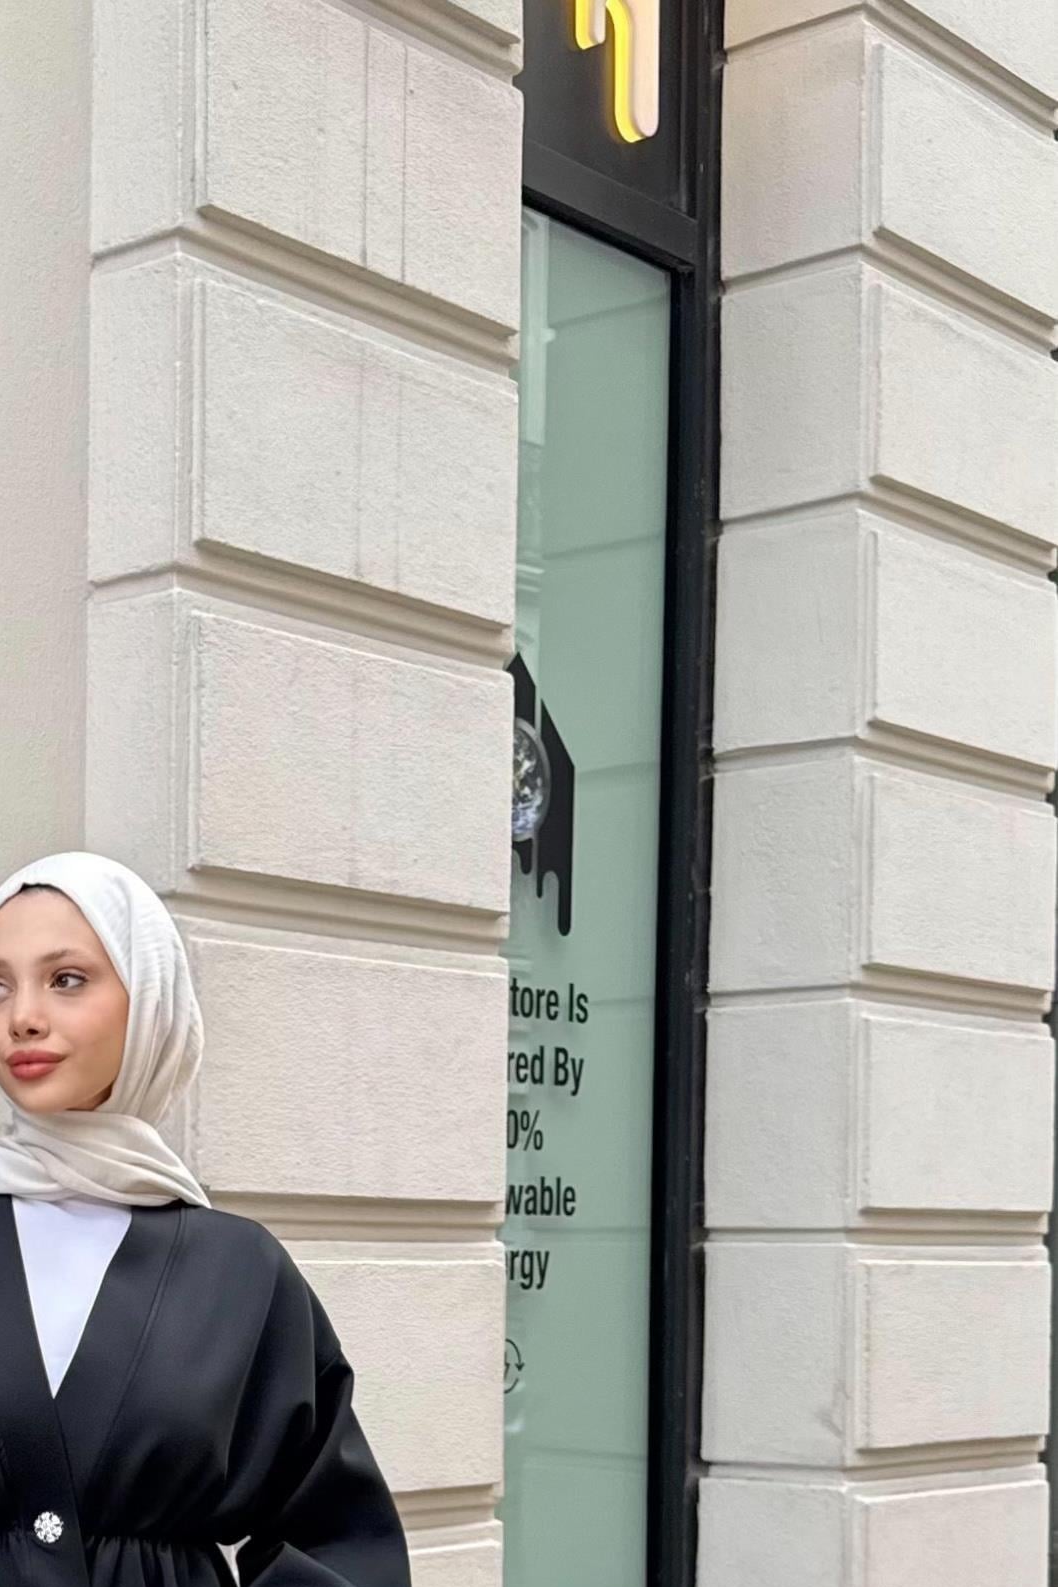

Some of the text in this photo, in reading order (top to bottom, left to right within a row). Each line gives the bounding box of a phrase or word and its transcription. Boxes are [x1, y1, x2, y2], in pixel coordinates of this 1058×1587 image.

[568, 982, 589, 1024] Is
[554, 1046, 584, 1096] By
[506, 1249, 549, 1290] rgy
